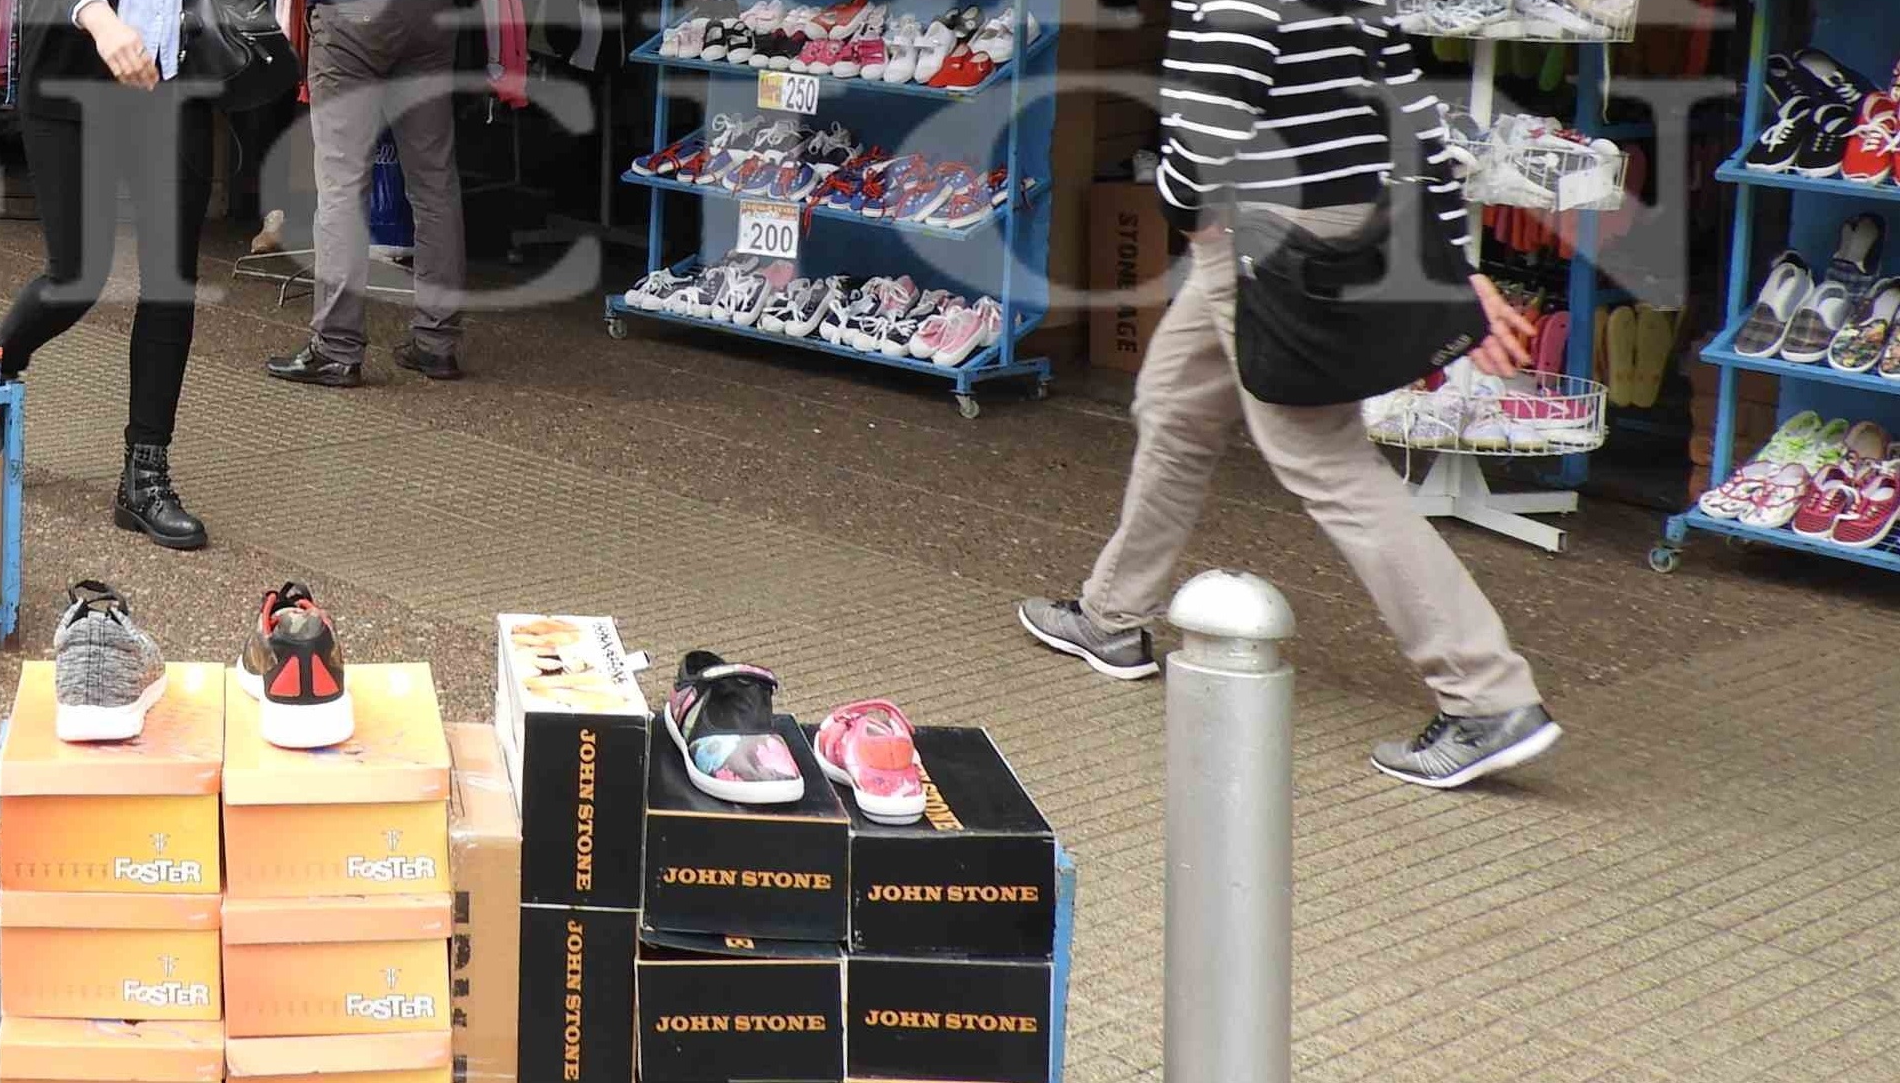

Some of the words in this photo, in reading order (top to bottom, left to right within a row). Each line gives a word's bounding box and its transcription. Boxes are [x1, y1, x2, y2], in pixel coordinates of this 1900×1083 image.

[786, 76, 816, 112] 250
[750, 222, 794, 253] 200
[1116, 210, 1140, 290] STONE
[578, 728, 597, 800] JOHN
[575, 802, 595, 892] STONE
[113, 856, 203, 885] FOSTER
[346, 855, 436, 883] FOSTER
[662, 866, 739, 887] JOHN
[741, 870, 833, 890] STONE
[867, 884, 945, 903] JOHN
[946, 885, 1040, 903] STONE
[564, 919, 585, 992] JOHN
[122, 978, 210, 1007] FOSTER
[345, 993, 436, 1020] FOSTER
[655, 1014, 731, 1033] JOHN
[733, 1014, 827, 1033] STONE
[864, 1009, 942, 1029] JOHN
[944, 1013, 1038, 1034] STONE
[562, 993, 584, 1082] STONE
